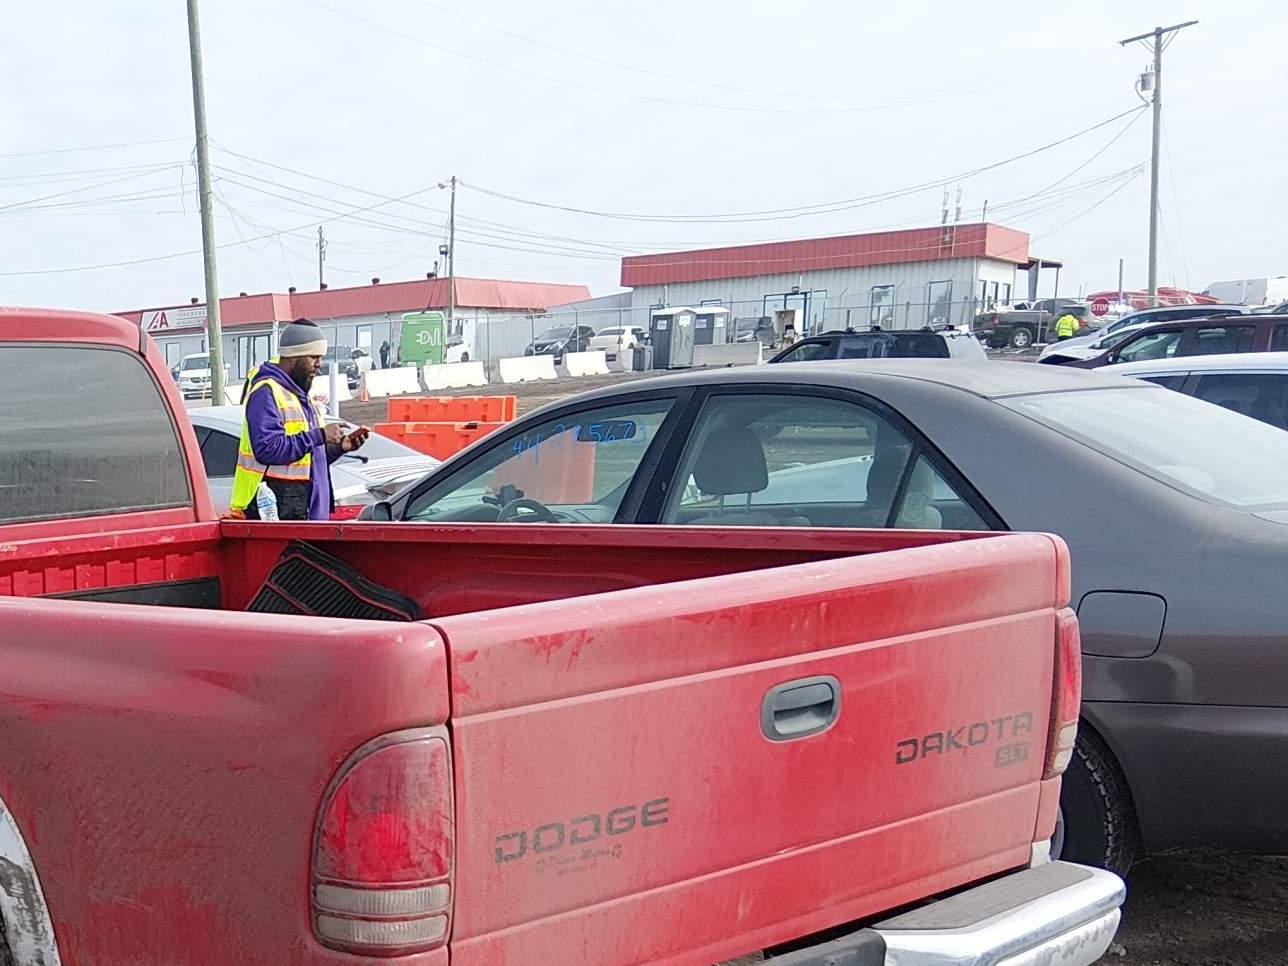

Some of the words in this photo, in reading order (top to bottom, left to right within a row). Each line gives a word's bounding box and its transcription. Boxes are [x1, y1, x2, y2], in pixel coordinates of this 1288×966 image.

[1092, 303, 1108, 312] STOP
[895, 711, 1033, 765] DAKOTA
[494, 796, 671, 864] DODGE
